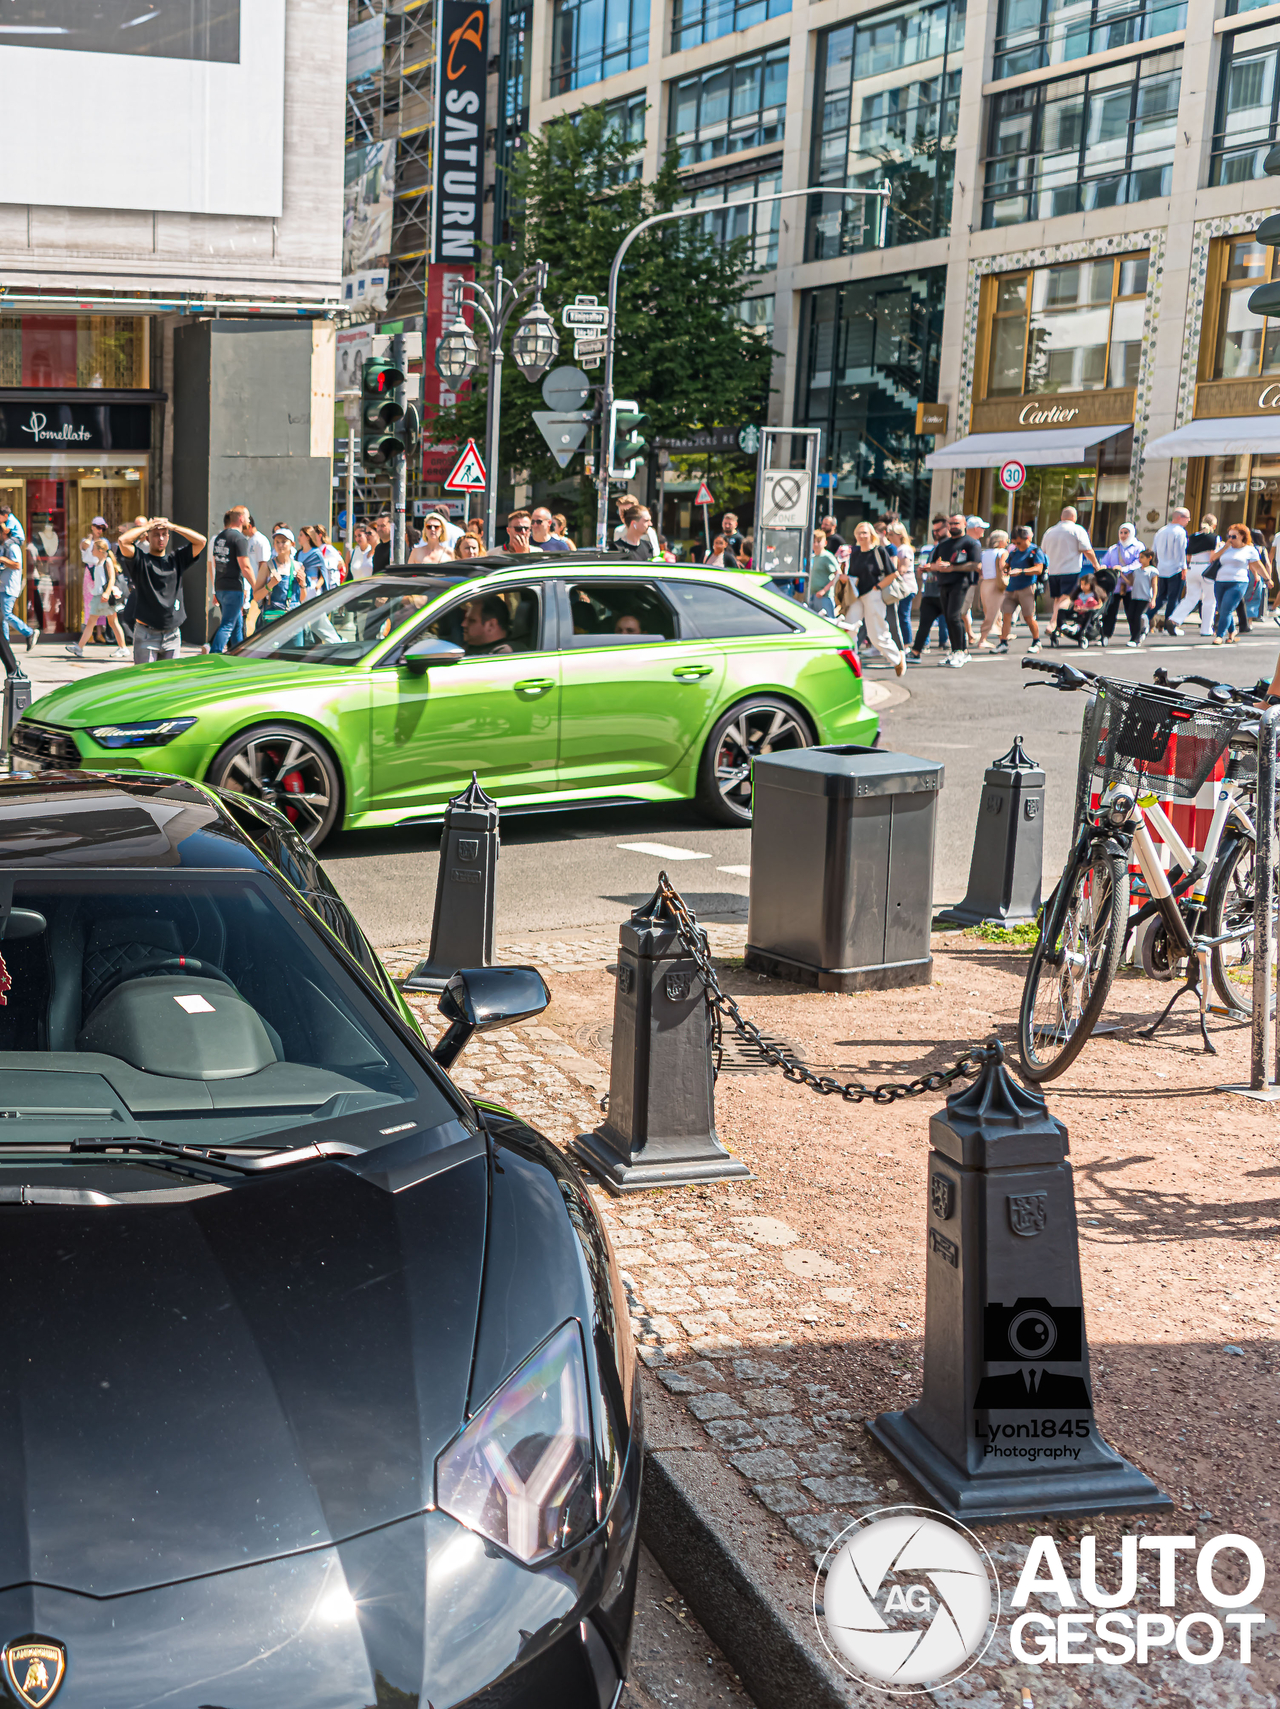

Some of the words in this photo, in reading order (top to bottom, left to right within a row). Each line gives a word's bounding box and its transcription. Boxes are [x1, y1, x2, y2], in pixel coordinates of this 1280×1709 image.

[442, 89, 480, 257] SATURN
[21, 411, 92, 443] Pomellato
[1019, 401, 1080, 426] Cartier
[1005, 469, 1020, 483] 30
